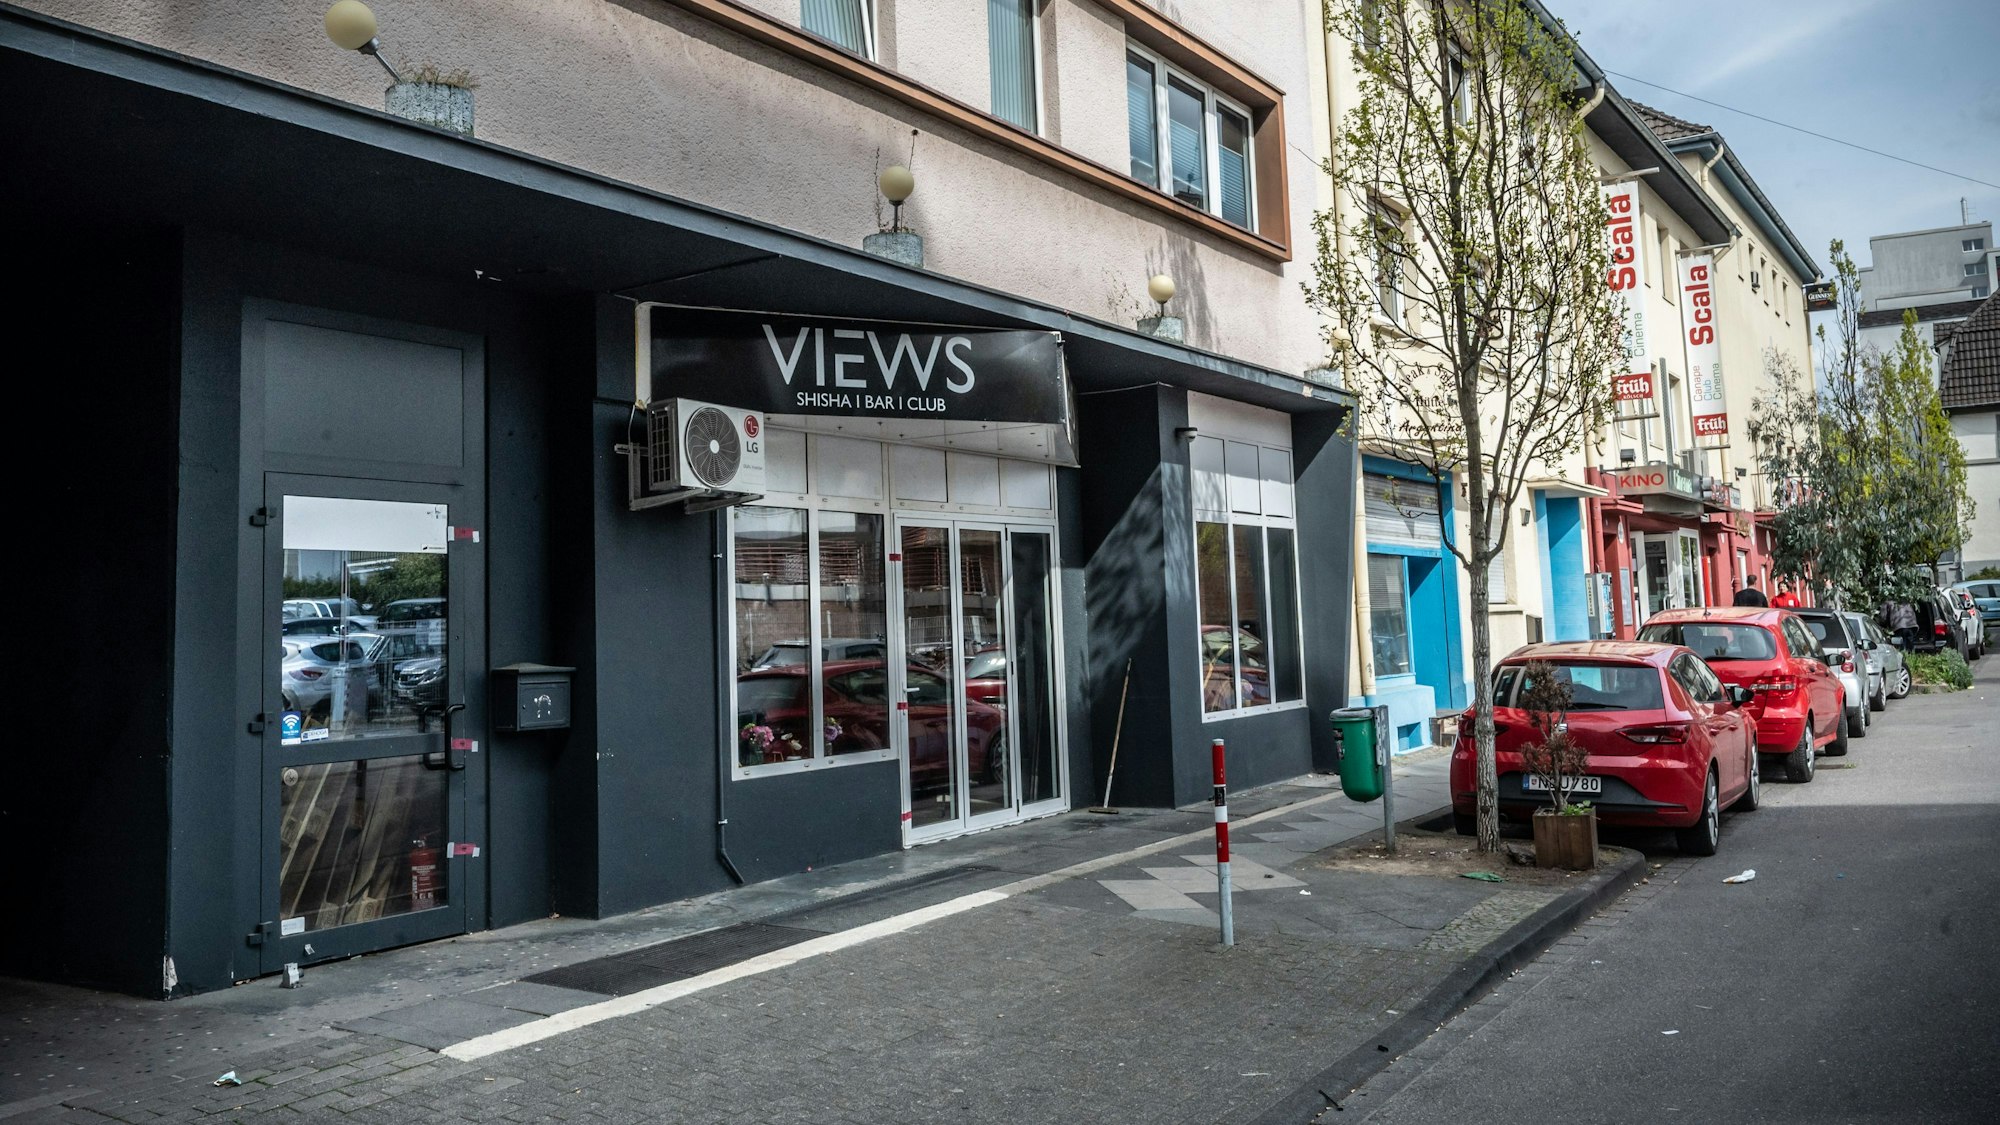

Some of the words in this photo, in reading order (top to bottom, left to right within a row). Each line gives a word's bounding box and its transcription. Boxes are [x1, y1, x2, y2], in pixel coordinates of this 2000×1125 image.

[1605, 194, 1636, 291] Scala
[1685, 265, 1714, 346] Scala
[1634, 312, 1645, 357] Cinema
[762, 324, 975, 394] VIEWS
[1693, 365, 1703, 402] Canape
[1703, 379, 1713, 401] Club
[1712, 363, 1722, 400] Cinema
[797, 392, 852, 408] SHISHA
[865, 395, 895, 410] BAR
[907, 397, 946, 412] CLUB
[746, 441, 759, 454] LG
[1620, 473, 1665, 488] KINO
